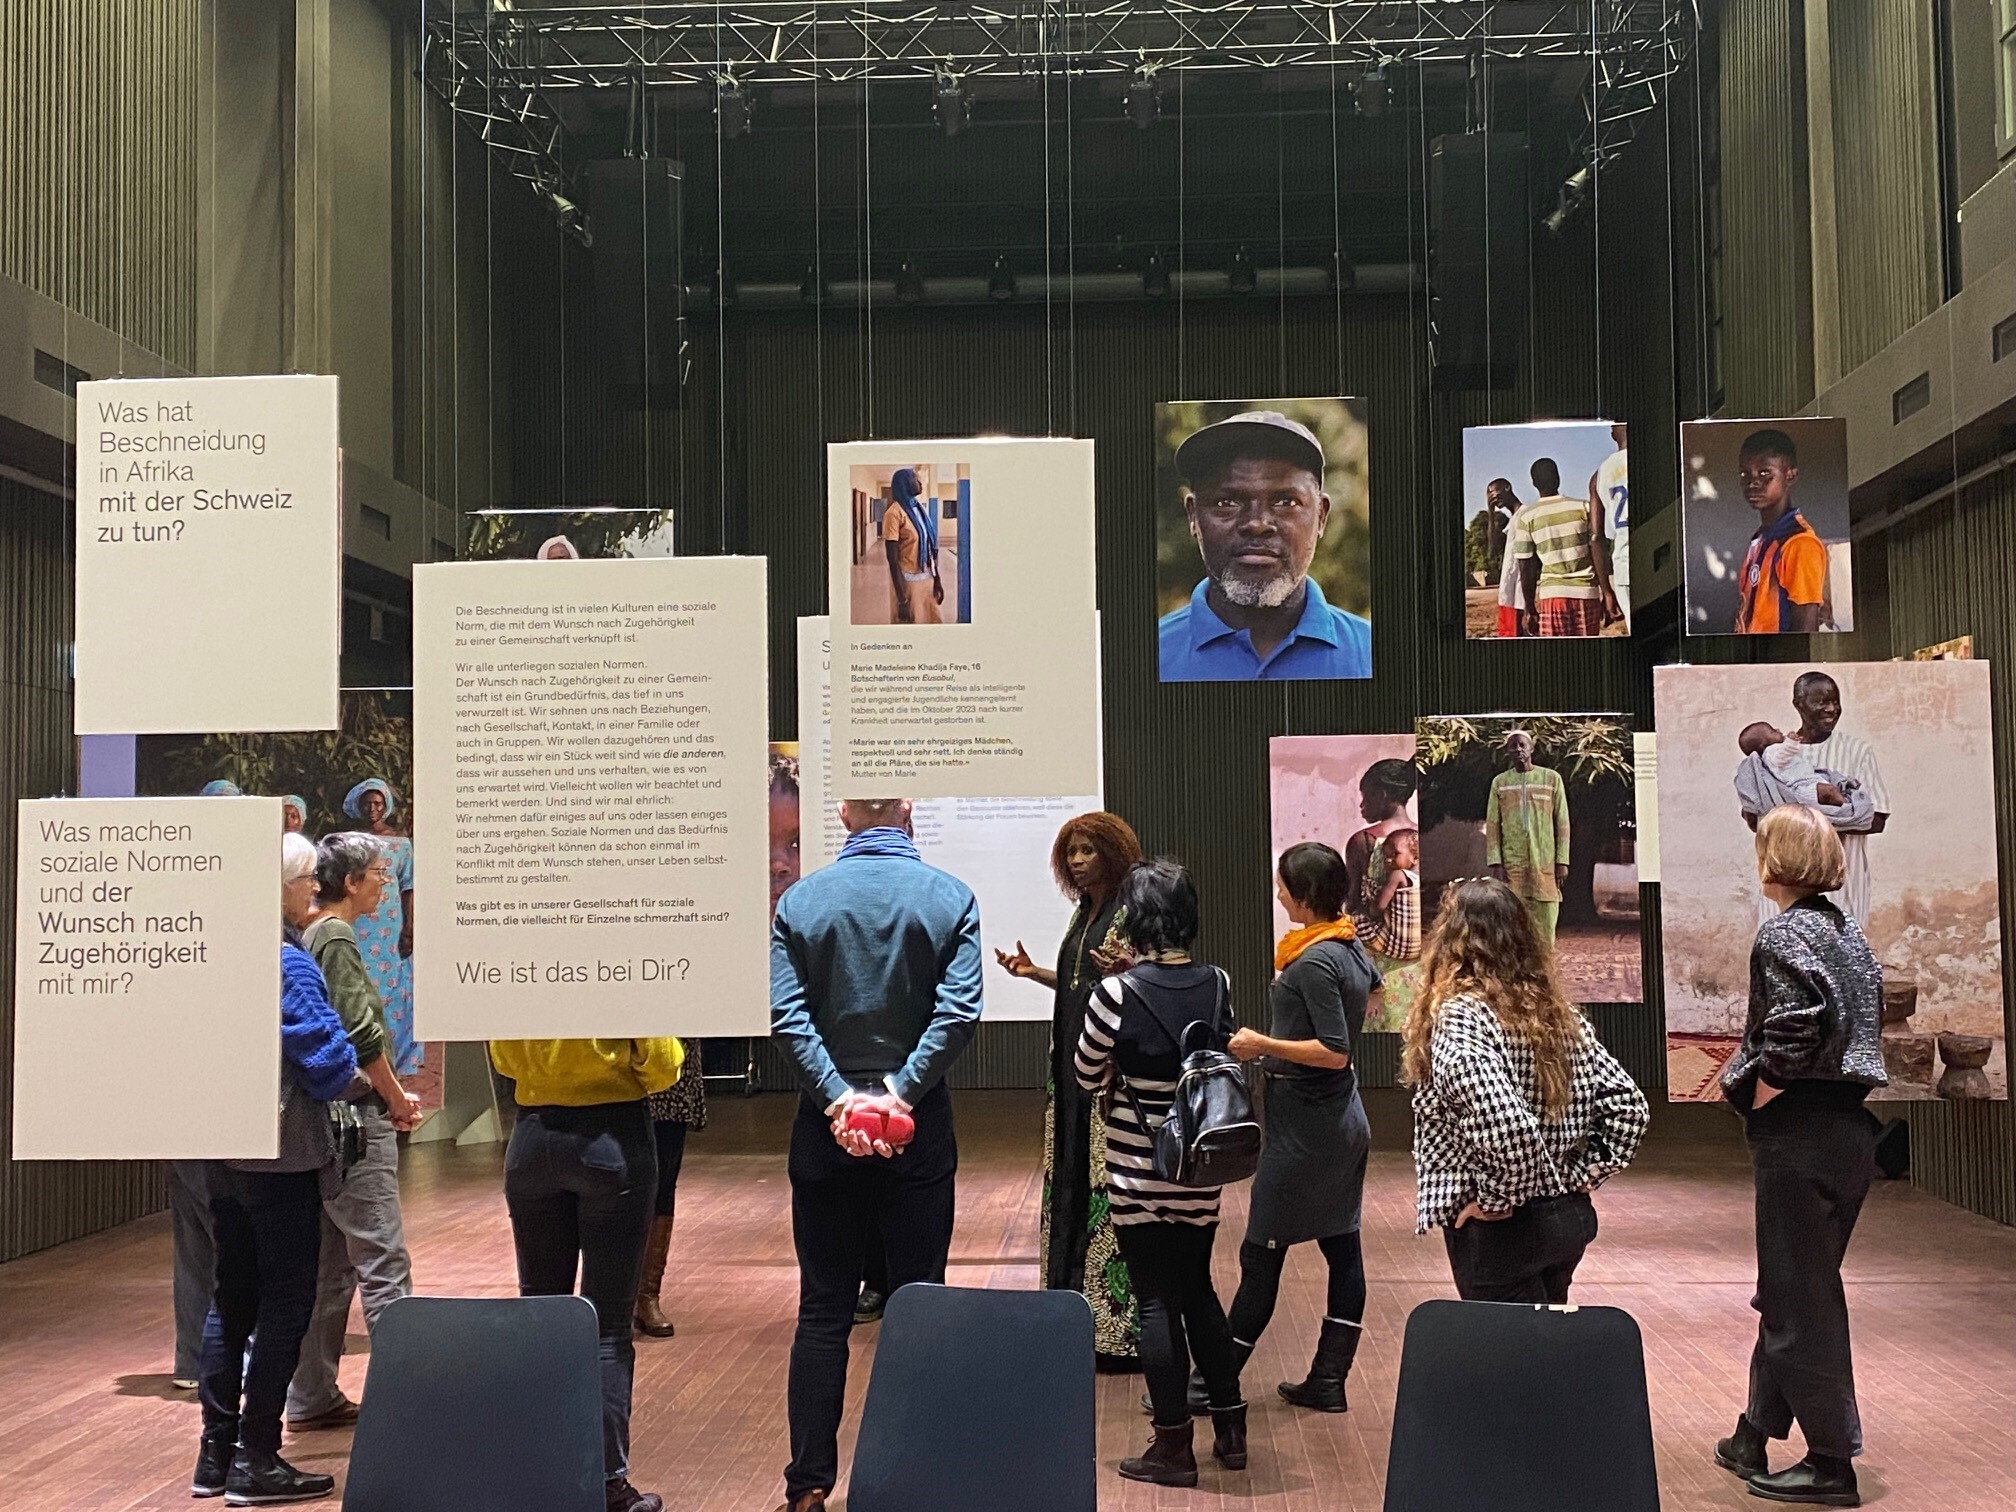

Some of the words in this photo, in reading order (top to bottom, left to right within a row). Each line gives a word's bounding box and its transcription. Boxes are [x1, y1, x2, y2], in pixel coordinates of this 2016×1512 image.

[98, 401, 148, 423] Was
[157, 400, 193, 422] hat
[100, 430, 266, 455] Beschneidung
[100, 461, 118, 483] in
[126, 459, 194, 482] Afrika
[99, 491, 136, 512] mit
[145, 490, 184, 512] der
[193, 487, 292, 511] Schweiz
[98, 526, 123, 543] zu
[132, 519, 185, 542] tun?
[455, 605, 473, 616] Die
[475, 604, 549, 617] Beschneidung
[551, 604, 564, 614] ist
[566, 604, 576, 613] in
[578, 603, 608, 613] vielen
[611, 602, 654, 612] Kulturen
[657, 604, 679, 612] eine
[681, 601, 716, 611] soziale
[455, 620, 487, 631] Norm,
[489, 620, 506, 630] die
[508, 620, 525, 630] mit
[527, 619, 551, 629] dem
[553, 618, 594, 629] Wunsch
[596, 618, 622, 628] nach
[624, 616, 695, 630] Zugehörigkeit
[455, 638, 467, 646] zu
[470, 637, 496, 646] einer
[498, 634, 570, 645] Gemeinschaft
[572, 633, 621, 644] verknüpft
[623, 632, 638, 642] ist.
[850, 642, 858, 651] In
[860, 642, 901, 650] Gedenken
[455, 662, 473, 672] Wir
[475, 662, 494, 672] alle
[497, 661, 556, 673] unterliegen
[558, 660, 600, 670] sozialen
[602, 659, 648, 669] Normen.
[850, 664, 873, 672] Marie
[874, 663, 916, 671] Madeleine
[917, 663, 948, 671] Khadija
[971, 662, 981, 670] 16
[455, 677, 475, 687] Der
[477, 676, 518, 687] Wunsch
[521, 676, 546, 686] nach
[549, 674, 620, 687] Zugehörigkeit
[623, 676, 635, 684] zu
[637, 675, 664, 684] einer
[667, 672, 712, 683] Gemein-
[850, 674, 904, 682] Botschafterin
[456, 692, 488, 702] schaft
[490, 692, 503, 702] ist
[505, 691, 522, 701] ein
[524, 689, 609, 701] Grundbedürfnis,
[611, 689, 630, 699] das
[633, 688, 650, 699] tief
[652, 690, 662, 698] in
[665, 690, 684, 698] uns
[850, 685, 864, 693] die
[879, 684, 913, 693] während
[945, 684, 968, 692] Reise
[982, 684, 1026, 693] intelligente
[455, 707, 509, 717] verwurzelt
[511, 706, 526, 716] ist.
[529, 706, 547, 716] Wir
[549, 706, 588, 715] sehnen
[590, 707, 609, 715] uns
[612, 704, 638, 714] nach
[640, 703, 710, 715] Beziehungen,
[878, 706, 895, 714] und
[921, 705, 954, 713] Oktober
[955, 705, 976, 713] 2023
[978, 705, 998, 713] nach
[926, 737, 973, 746] ehrgeiziges
[851, 748, 895, 757] respektvoll
[896, 748, 912, 756] und
[967, 747, 992, 755] denke
[993, 747, 1024, 756] ständig
[863, 759, 873, 767] all
[874, 759, 887, 767] die
[894, 769, 916, 777] Marie
[455, 813, 473, 823] Wir
[475, 814, 517, 823] nehmen
[519, 812, 547, 822] dafür
[549, 811, 586, 823] einiges
[588, 811, 605, 821] auf
[607, 812, 626, 820] uns
[629, 810, 653, 820] oder
[655, 810, 688, 820] lassen
[690, 810, 728, 821] einiges
[40, 820, 90, 842] Was
[99, 820, 191, 842] machen
[40, 851, 118, 873] soziale
[127, 850, 222, 872] Normen
[456, 874, 504, 884] bestimmt
[506, 875, 518, 883] zu
[521, 872, 570, 885] gestalten.
[40, 881, 83, 903] und
[92, 880, 132, 903] der
[456, 901, 477, 910] Was
[480, 900, 501, 912] gibt
[503, 902, 516, 910] es
[518, 899, 528, 909] in
[531, 901, 571, 909] unserer
[573, 897, 638, 909] Gesellschaft
[641, 897, 656, 907] für
[658, 897, 694, 907] soziale
[38, 911, 134, 933] Wunsch
[145, 911, 203, 932] nach
[456, 916, 501, 926] Normen,
[502, 915, 519, 925] die
[521, 914, 567, 925] vielleicht
[569, 914, 584, 924] für
[587, 913, 631, 924] Einzelne
[633, 912, 699, 923] schmerzhaft
[701, 911, 730, 922] sind?
[39, 941, 207, 969] Zugehörigkeit
[456, 961, 501, 984] Wie
[511, 961, 537, 983] ist
[545, 960, 588, 983] das
[597, 959, 632, 982] bei
[642, 957, 690, 981] Dir?
[38, 972, 74, 994] mit
[83, 971, 133, 994] mir?
